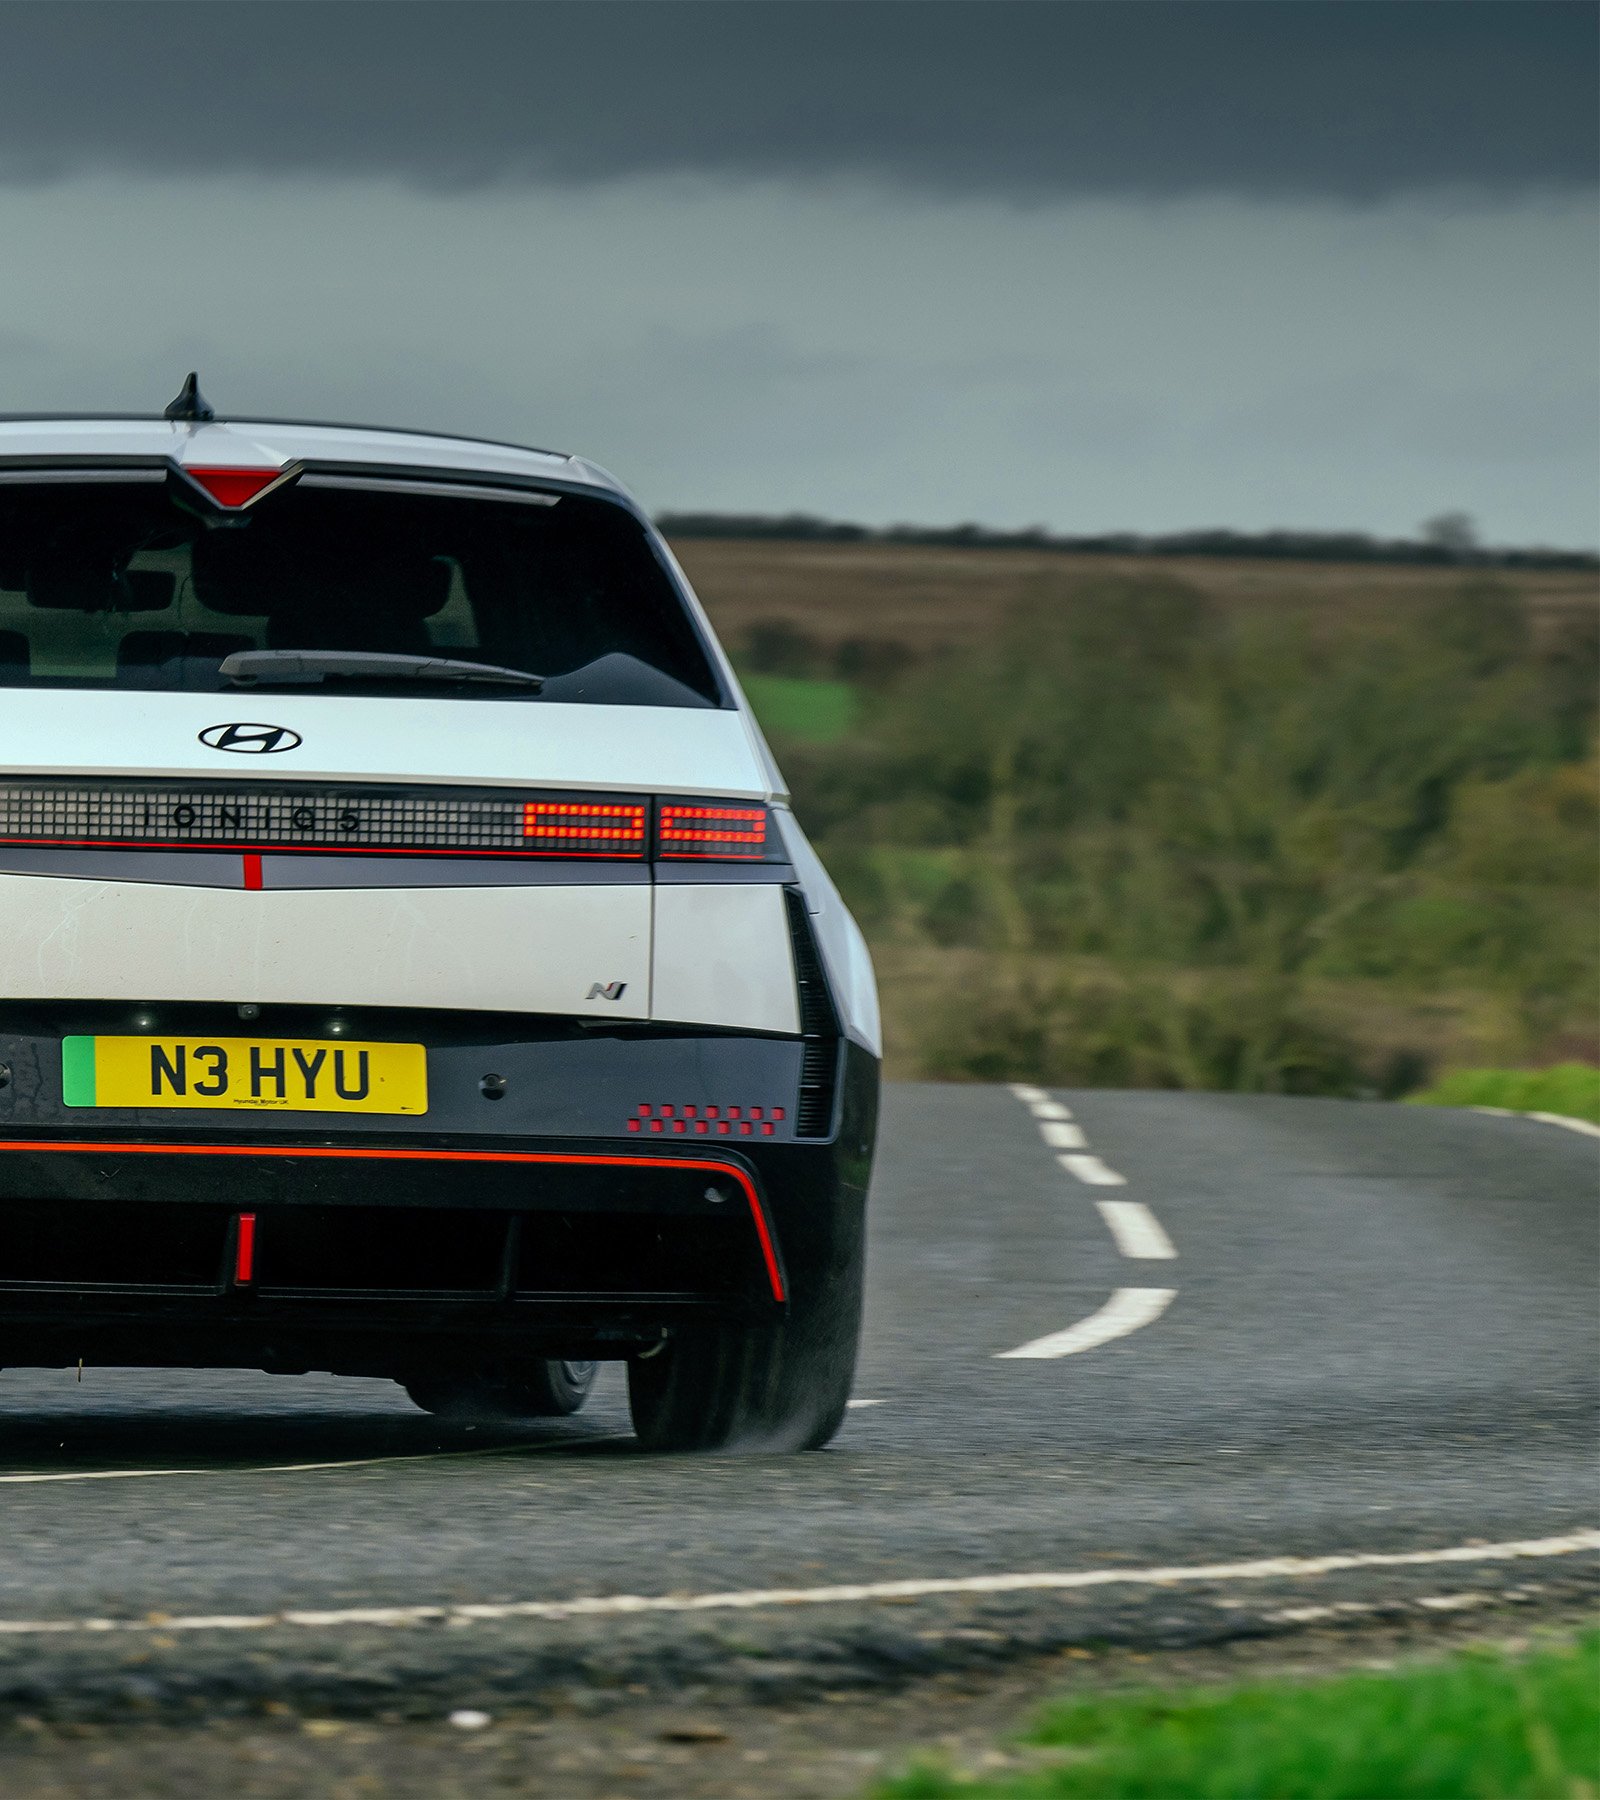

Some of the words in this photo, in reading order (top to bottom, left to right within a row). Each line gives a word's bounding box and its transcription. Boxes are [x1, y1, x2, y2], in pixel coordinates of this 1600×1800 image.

[340, 808, 360, 832] 5
[150, 1044, 228, 1096] N3
[249, 1046, 370, 1101] HYU
